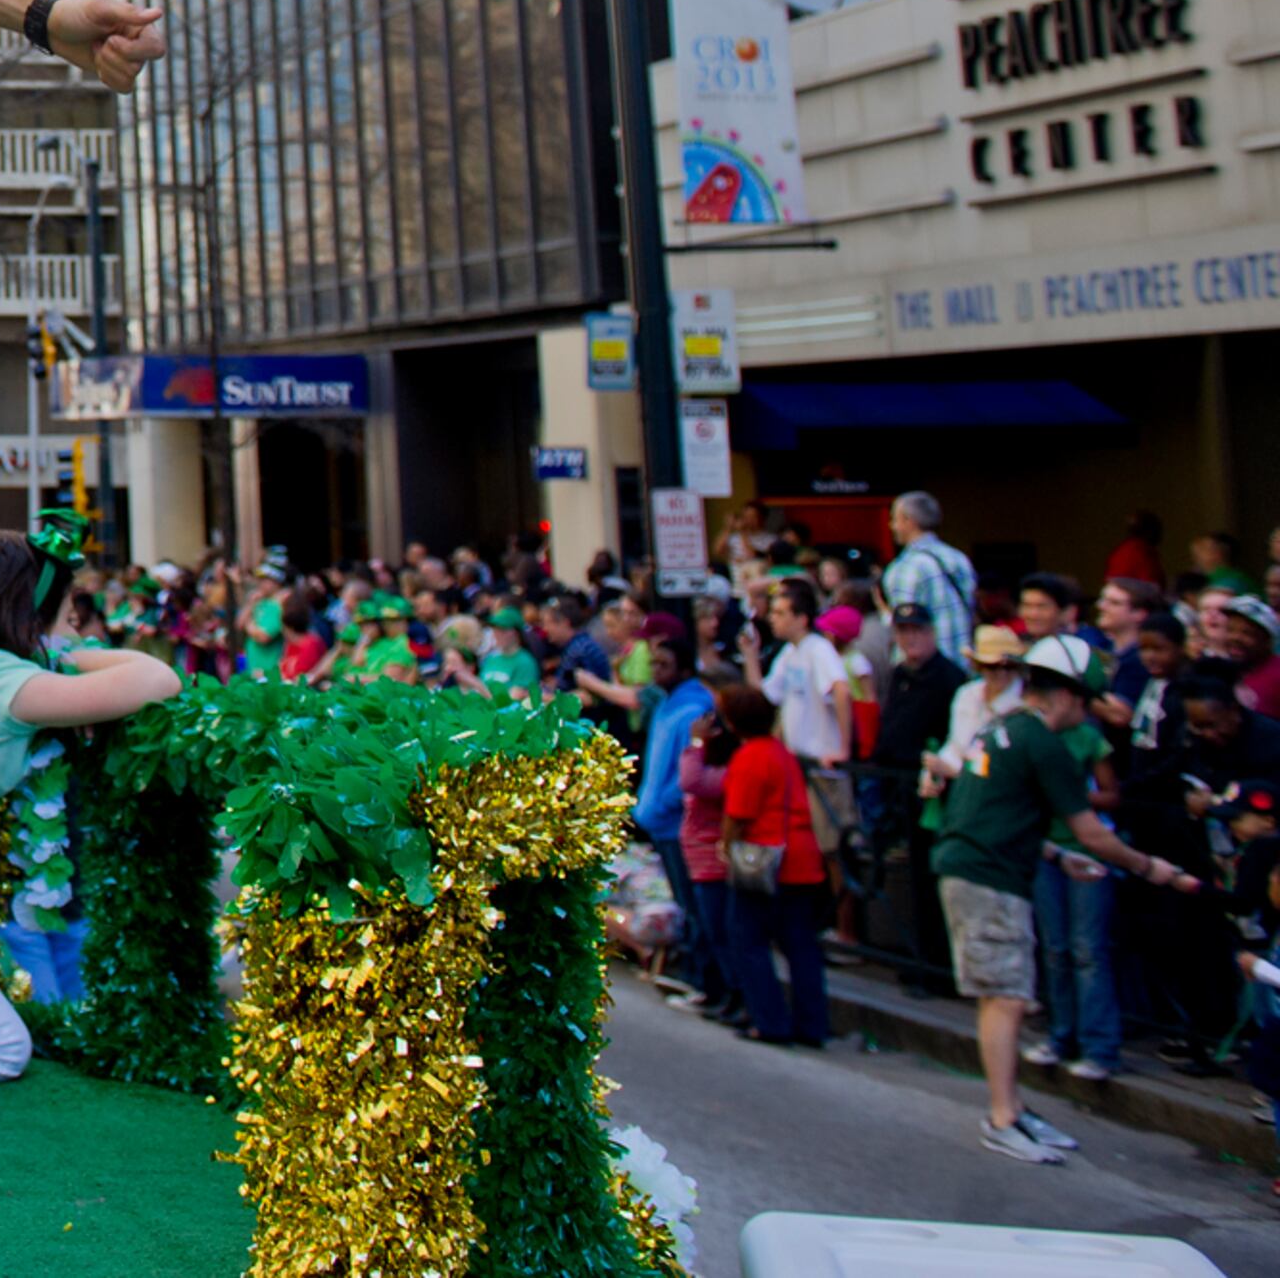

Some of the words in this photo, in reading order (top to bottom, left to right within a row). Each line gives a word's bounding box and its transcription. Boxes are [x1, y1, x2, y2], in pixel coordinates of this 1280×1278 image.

[696, 66, 777, 92] 2013
[970, 95, 1207, 185] CENTER
[1044, 263, 1183, 318] PEACHTREE
[1193, 250, 1280, 305] CENTE
